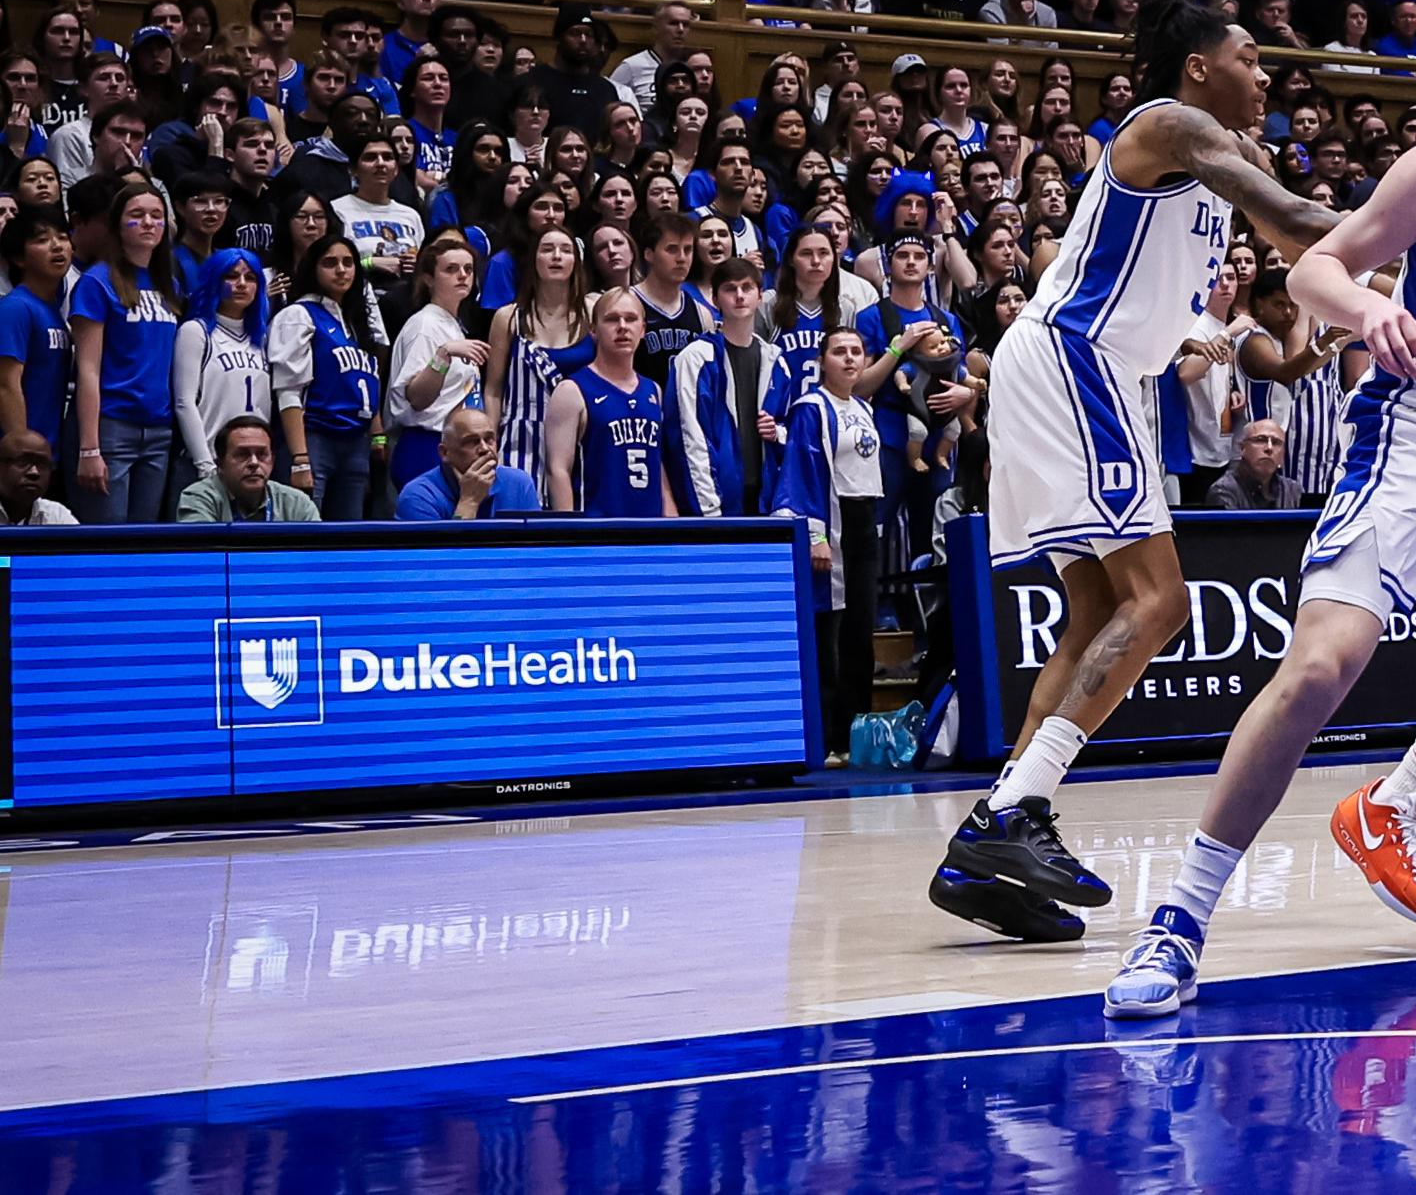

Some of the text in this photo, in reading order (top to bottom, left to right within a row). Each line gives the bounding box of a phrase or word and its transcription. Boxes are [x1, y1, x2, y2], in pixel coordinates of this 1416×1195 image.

[243, 376, 254, 413] 1
[357, 378, 373, 420] 1
[608, 418, 659, 447] DUKE
[626, 449, 650, 489] 5
[1100, 462, 1133, 492] D
[338, 636, 637, 695] DukeHealth
[495, 781, 572, 796] DAKTRONICS
